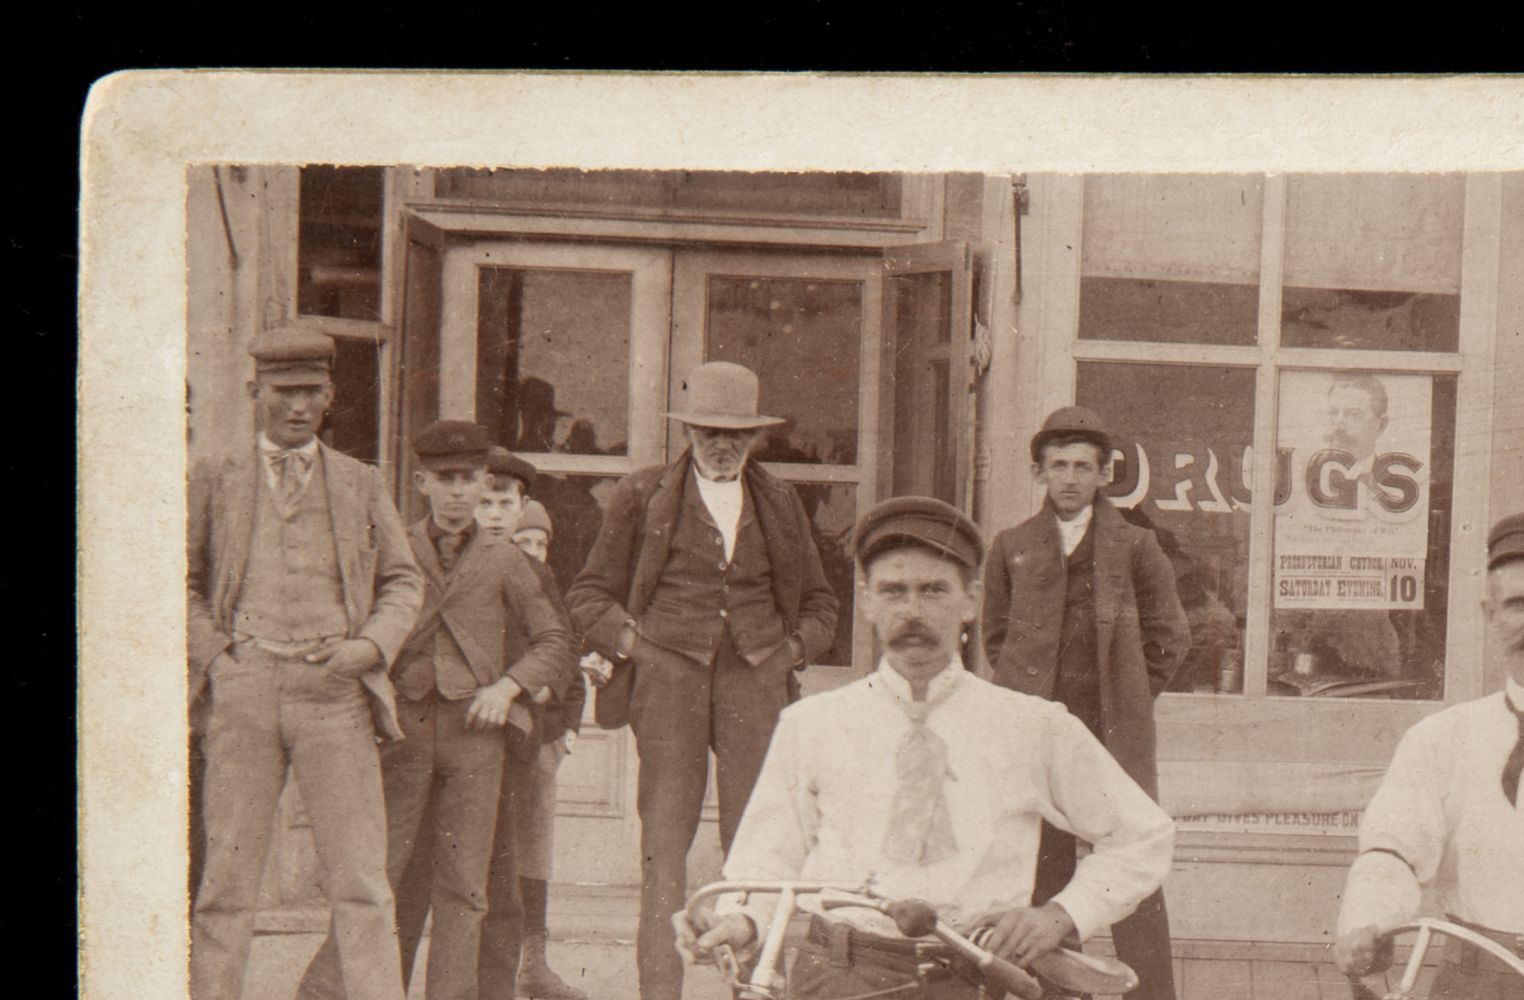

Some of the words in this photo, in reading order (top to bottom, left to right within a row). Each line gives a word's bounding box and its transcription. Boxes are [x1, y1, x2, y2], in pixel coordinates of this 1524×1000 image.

[1103, 443, 1424, 522] DRUGS
[1390, 557, 1417, 571] NOV.
[1279, 580, 1332, 597] SATURDAY
[1390, 574, 1418, 603] 10
[1265, 812, 1339, 828] PLEASURE
